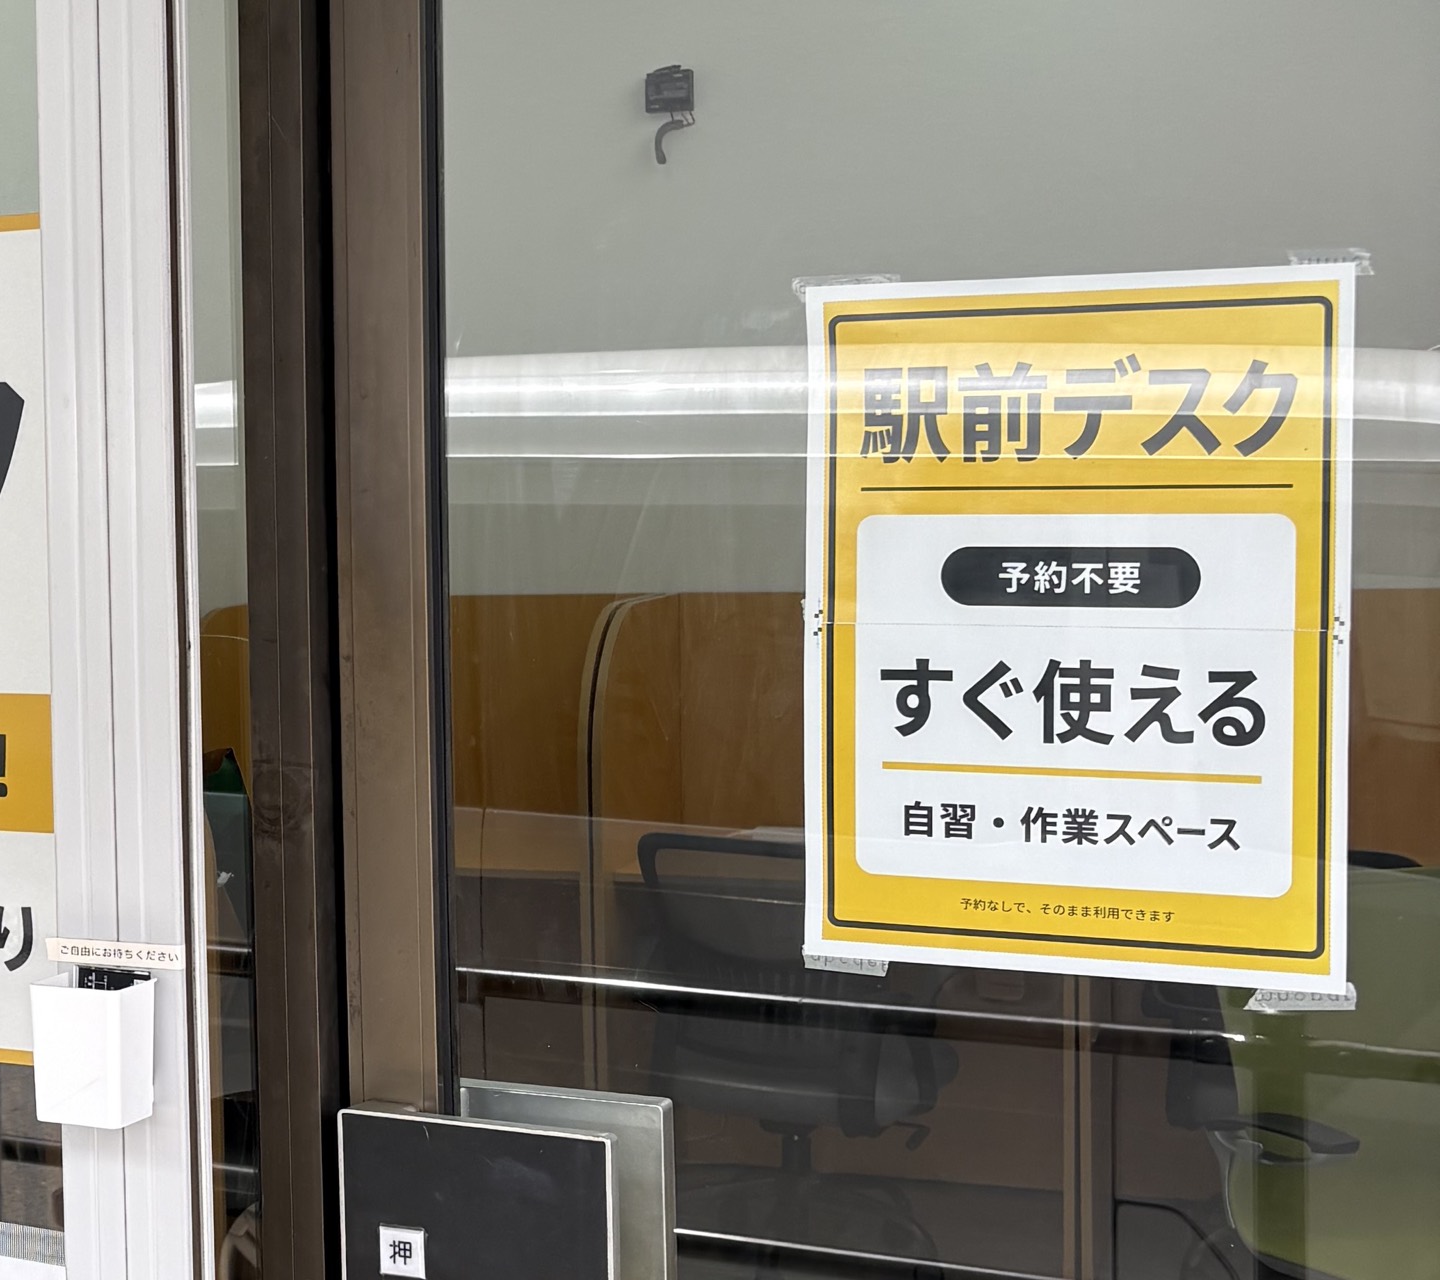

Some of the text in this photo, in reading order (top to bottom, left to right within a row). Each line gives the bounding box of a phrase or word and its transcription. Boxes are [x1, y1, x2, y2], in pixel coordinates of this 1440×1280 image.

[859, 352, 1299, 466] 駅前デスク
[997, 560, 1142, 596] 予約不要
[879, 657, 1268, 748] すぐ使える
[901, 800, 1241, 852] 自習・作業スペース
[960, 897, 1176, 923] 予約なしで、そのまま利用できます
[60, 945, 179, 963] ご自由にお持ちください
[388, 1239, 413, 1266] 押
